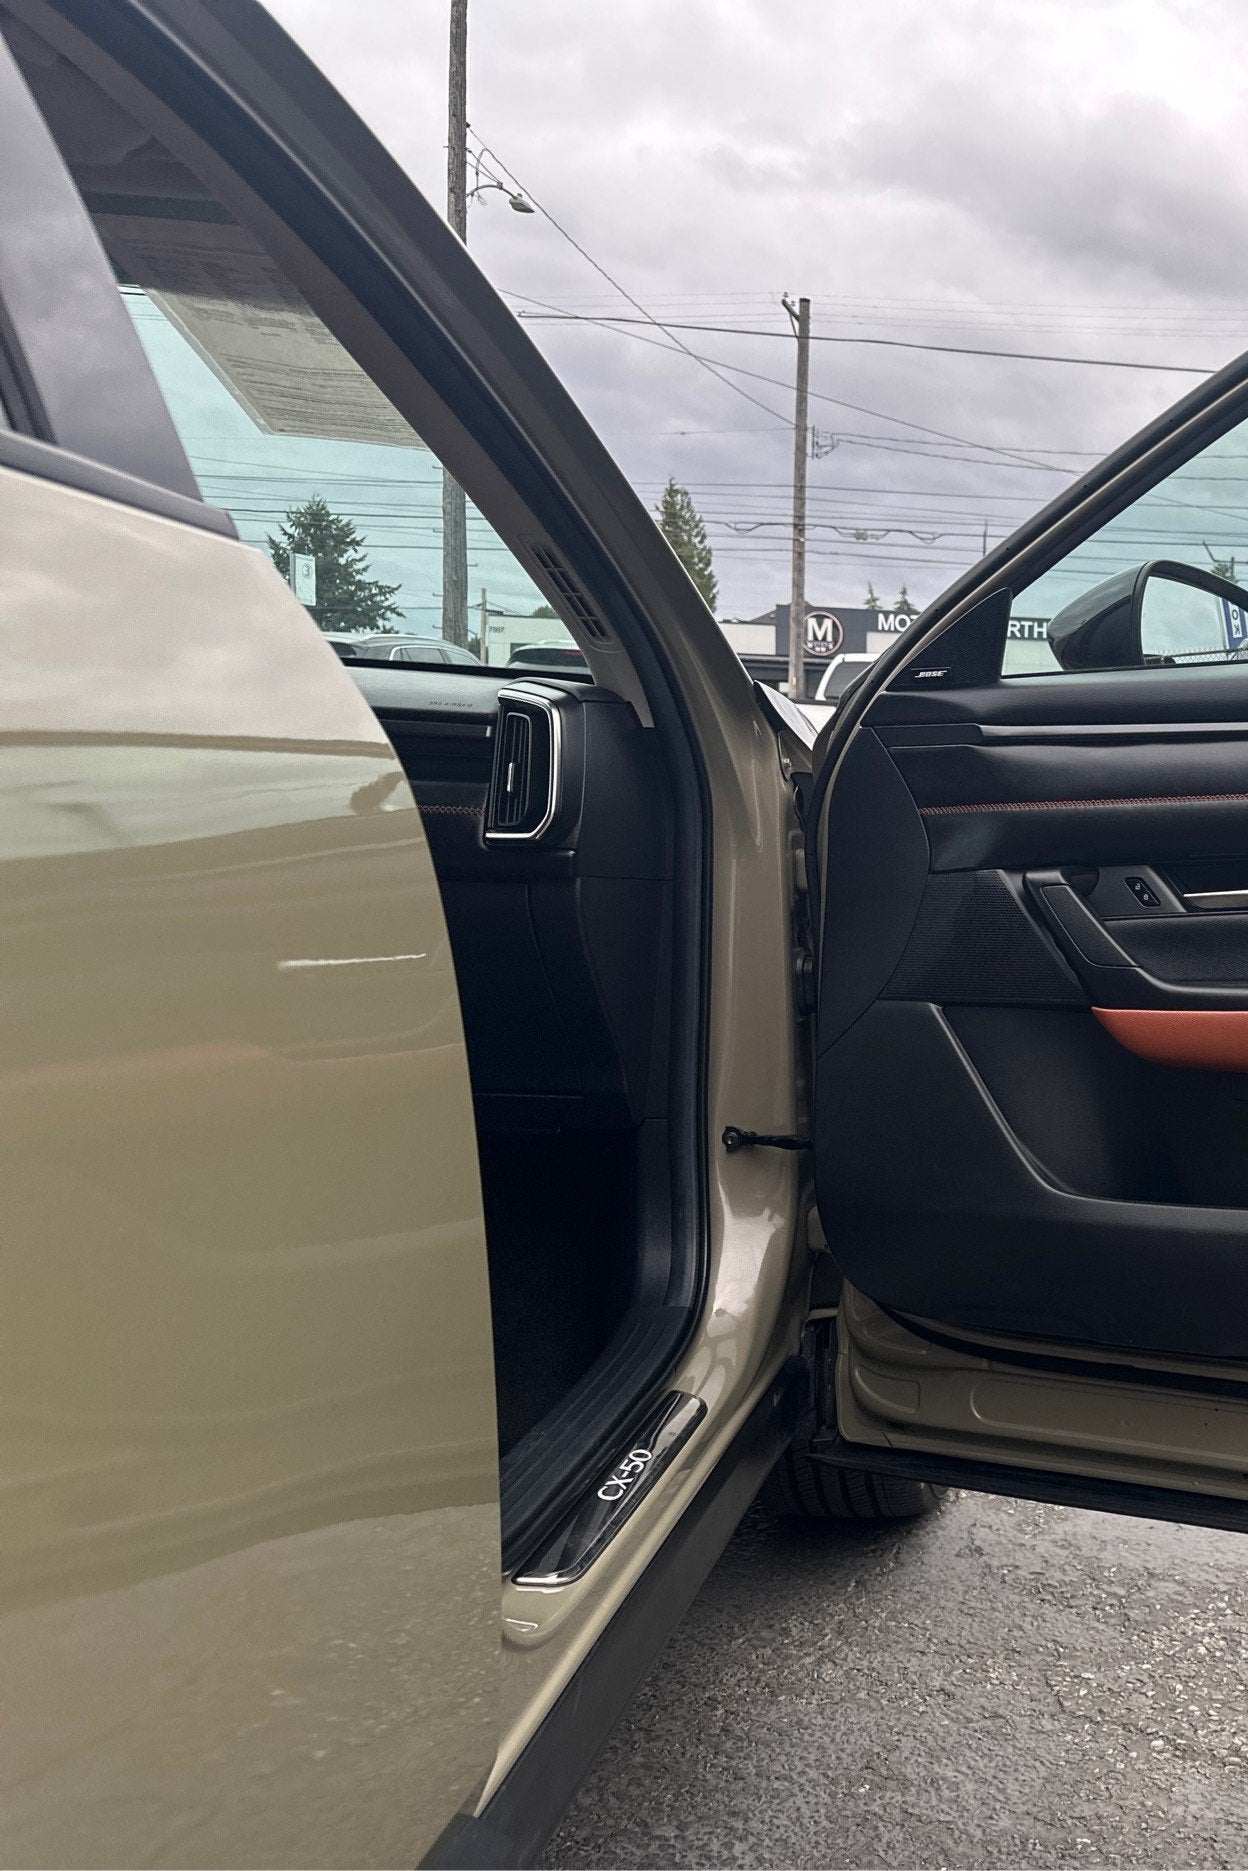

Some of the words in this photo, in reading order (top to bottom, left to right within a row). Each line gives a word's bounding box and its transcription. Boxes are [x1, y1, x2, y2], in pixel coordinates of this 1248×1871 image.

[807, 617, 834, 641] M
[914, 670, 947, 678] BOSE
[597, 1449, 652, 1501] CX-50
